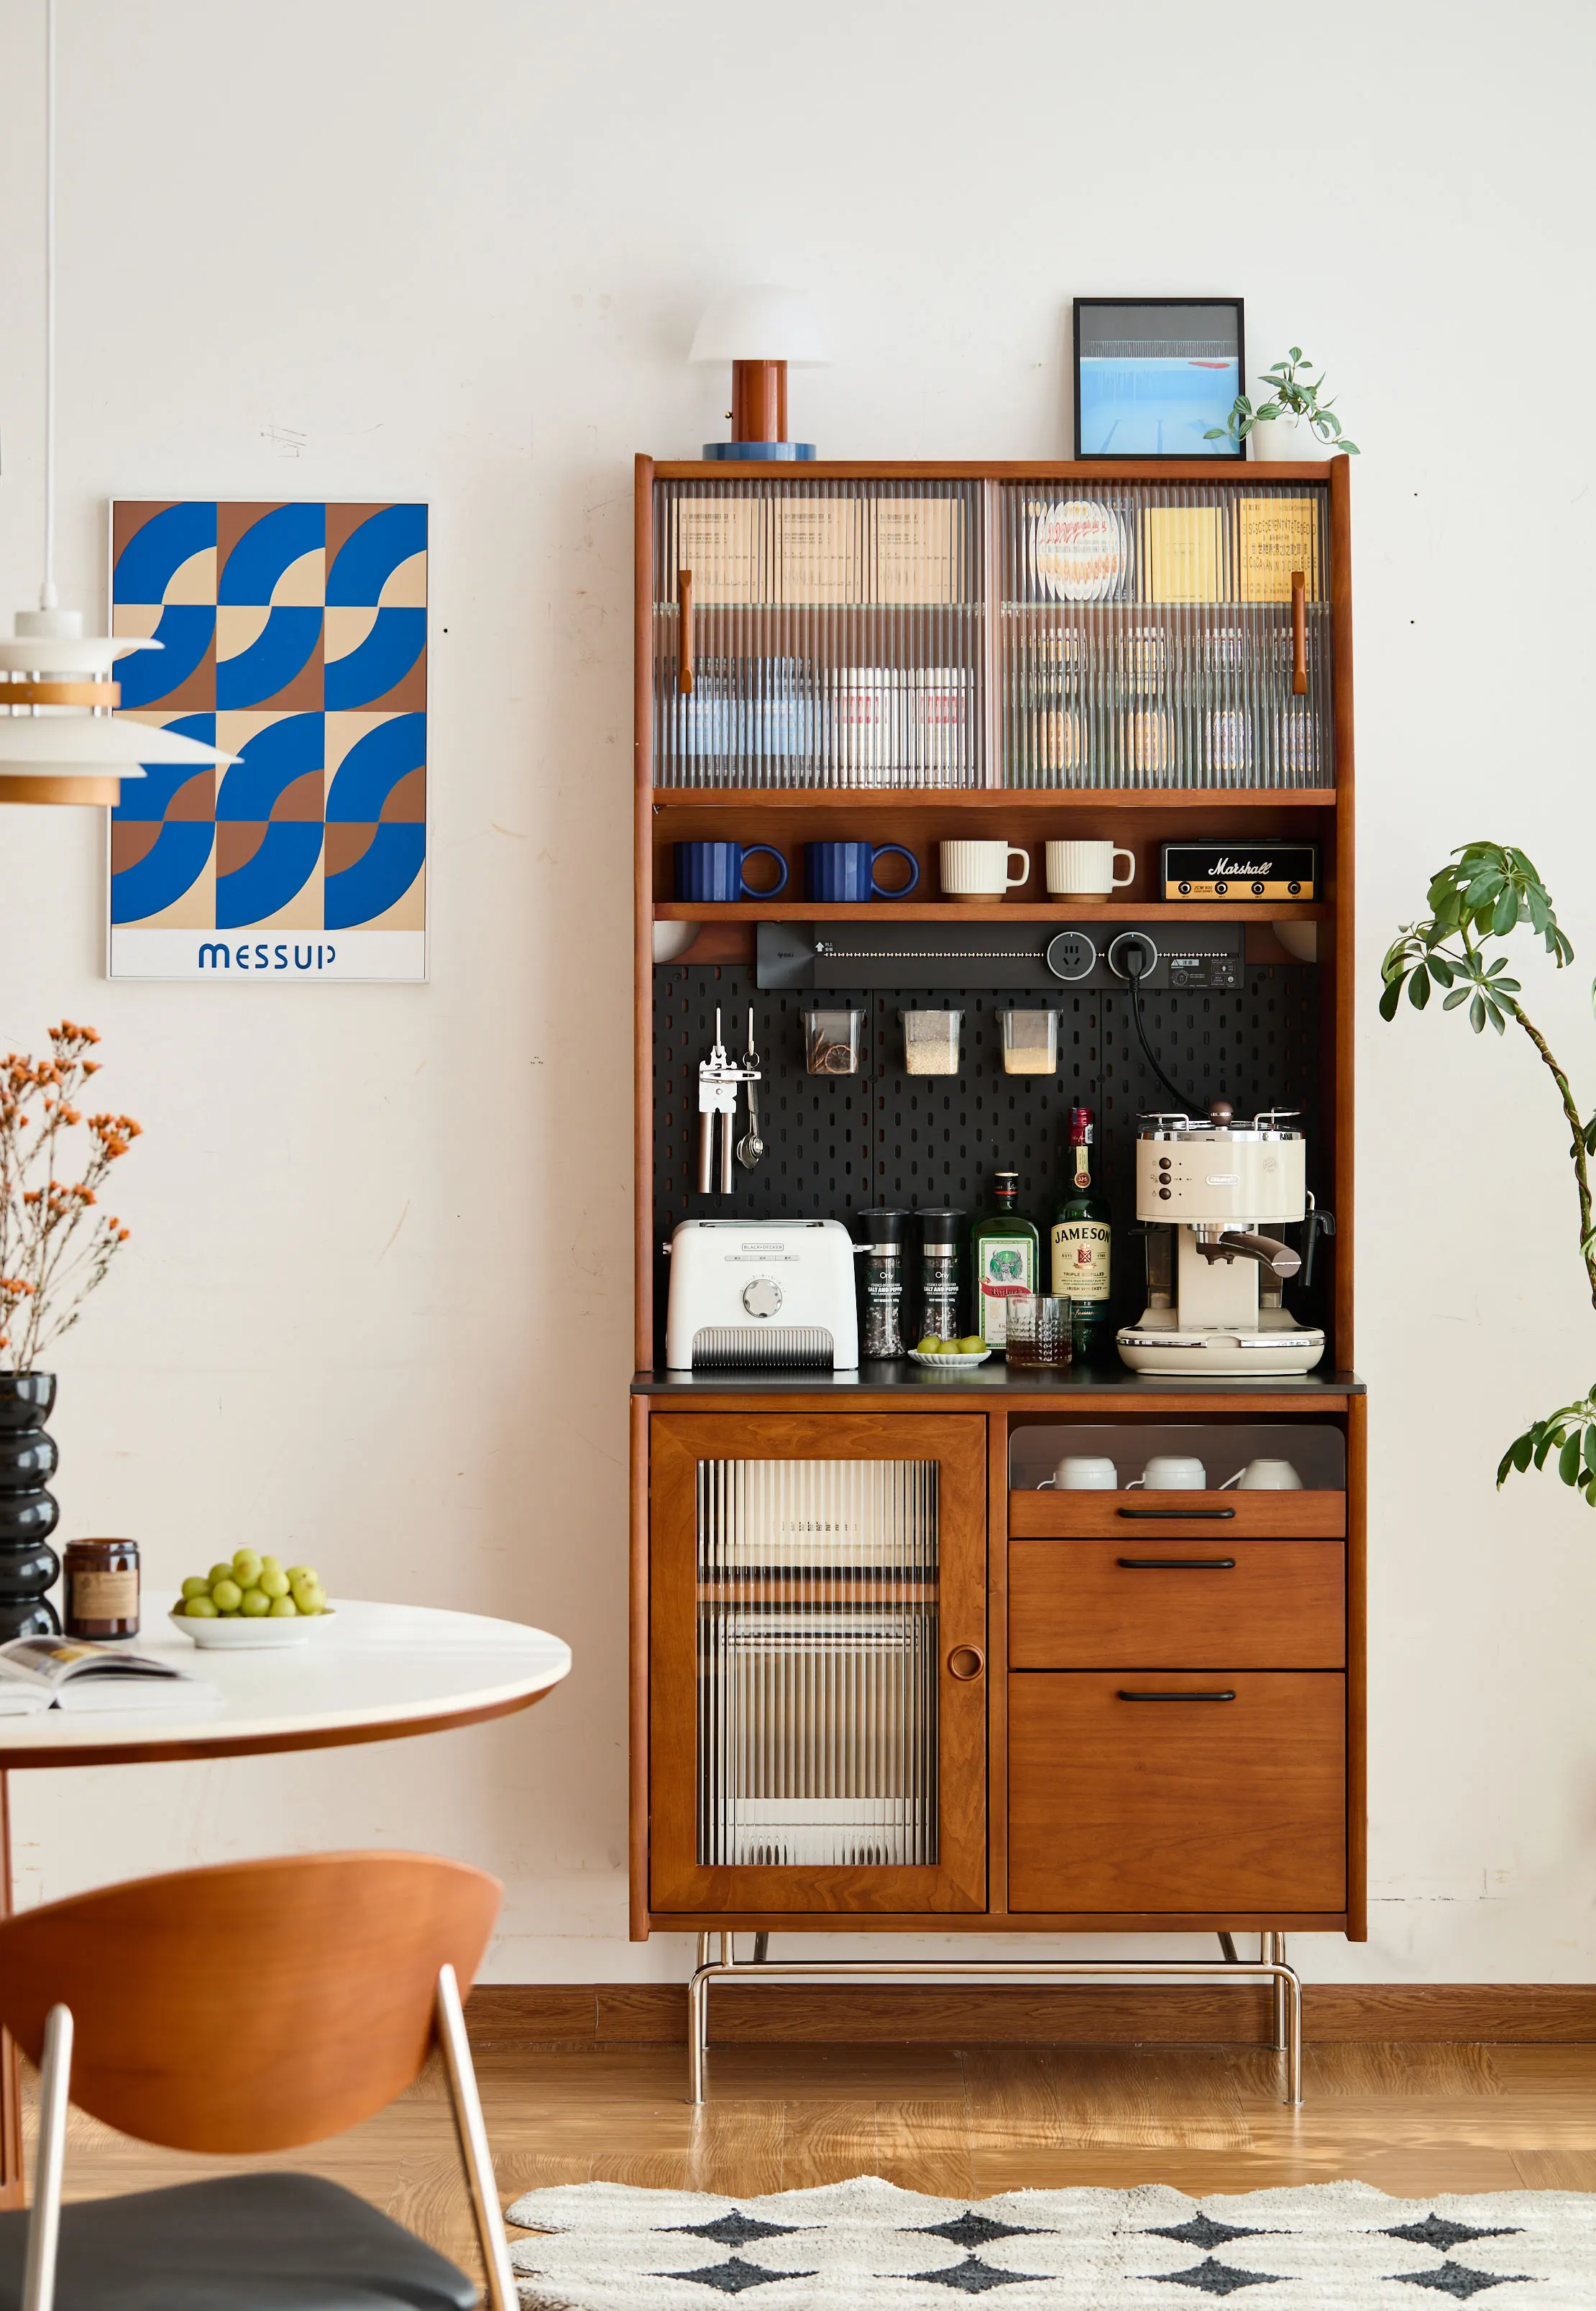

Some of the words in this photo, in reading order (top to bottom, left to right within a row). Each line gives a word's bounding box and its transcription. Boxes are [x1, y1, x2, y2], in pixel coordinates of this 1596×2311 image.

[1208, 857, 1272, 876] Marshall
[198, 943, 336, 970] MESSUP
[1055, 1227, 1110, 1244] JAMESON
[879, 1271, 894, 1280] Only
[935, 1271, 950, 1280] Only
